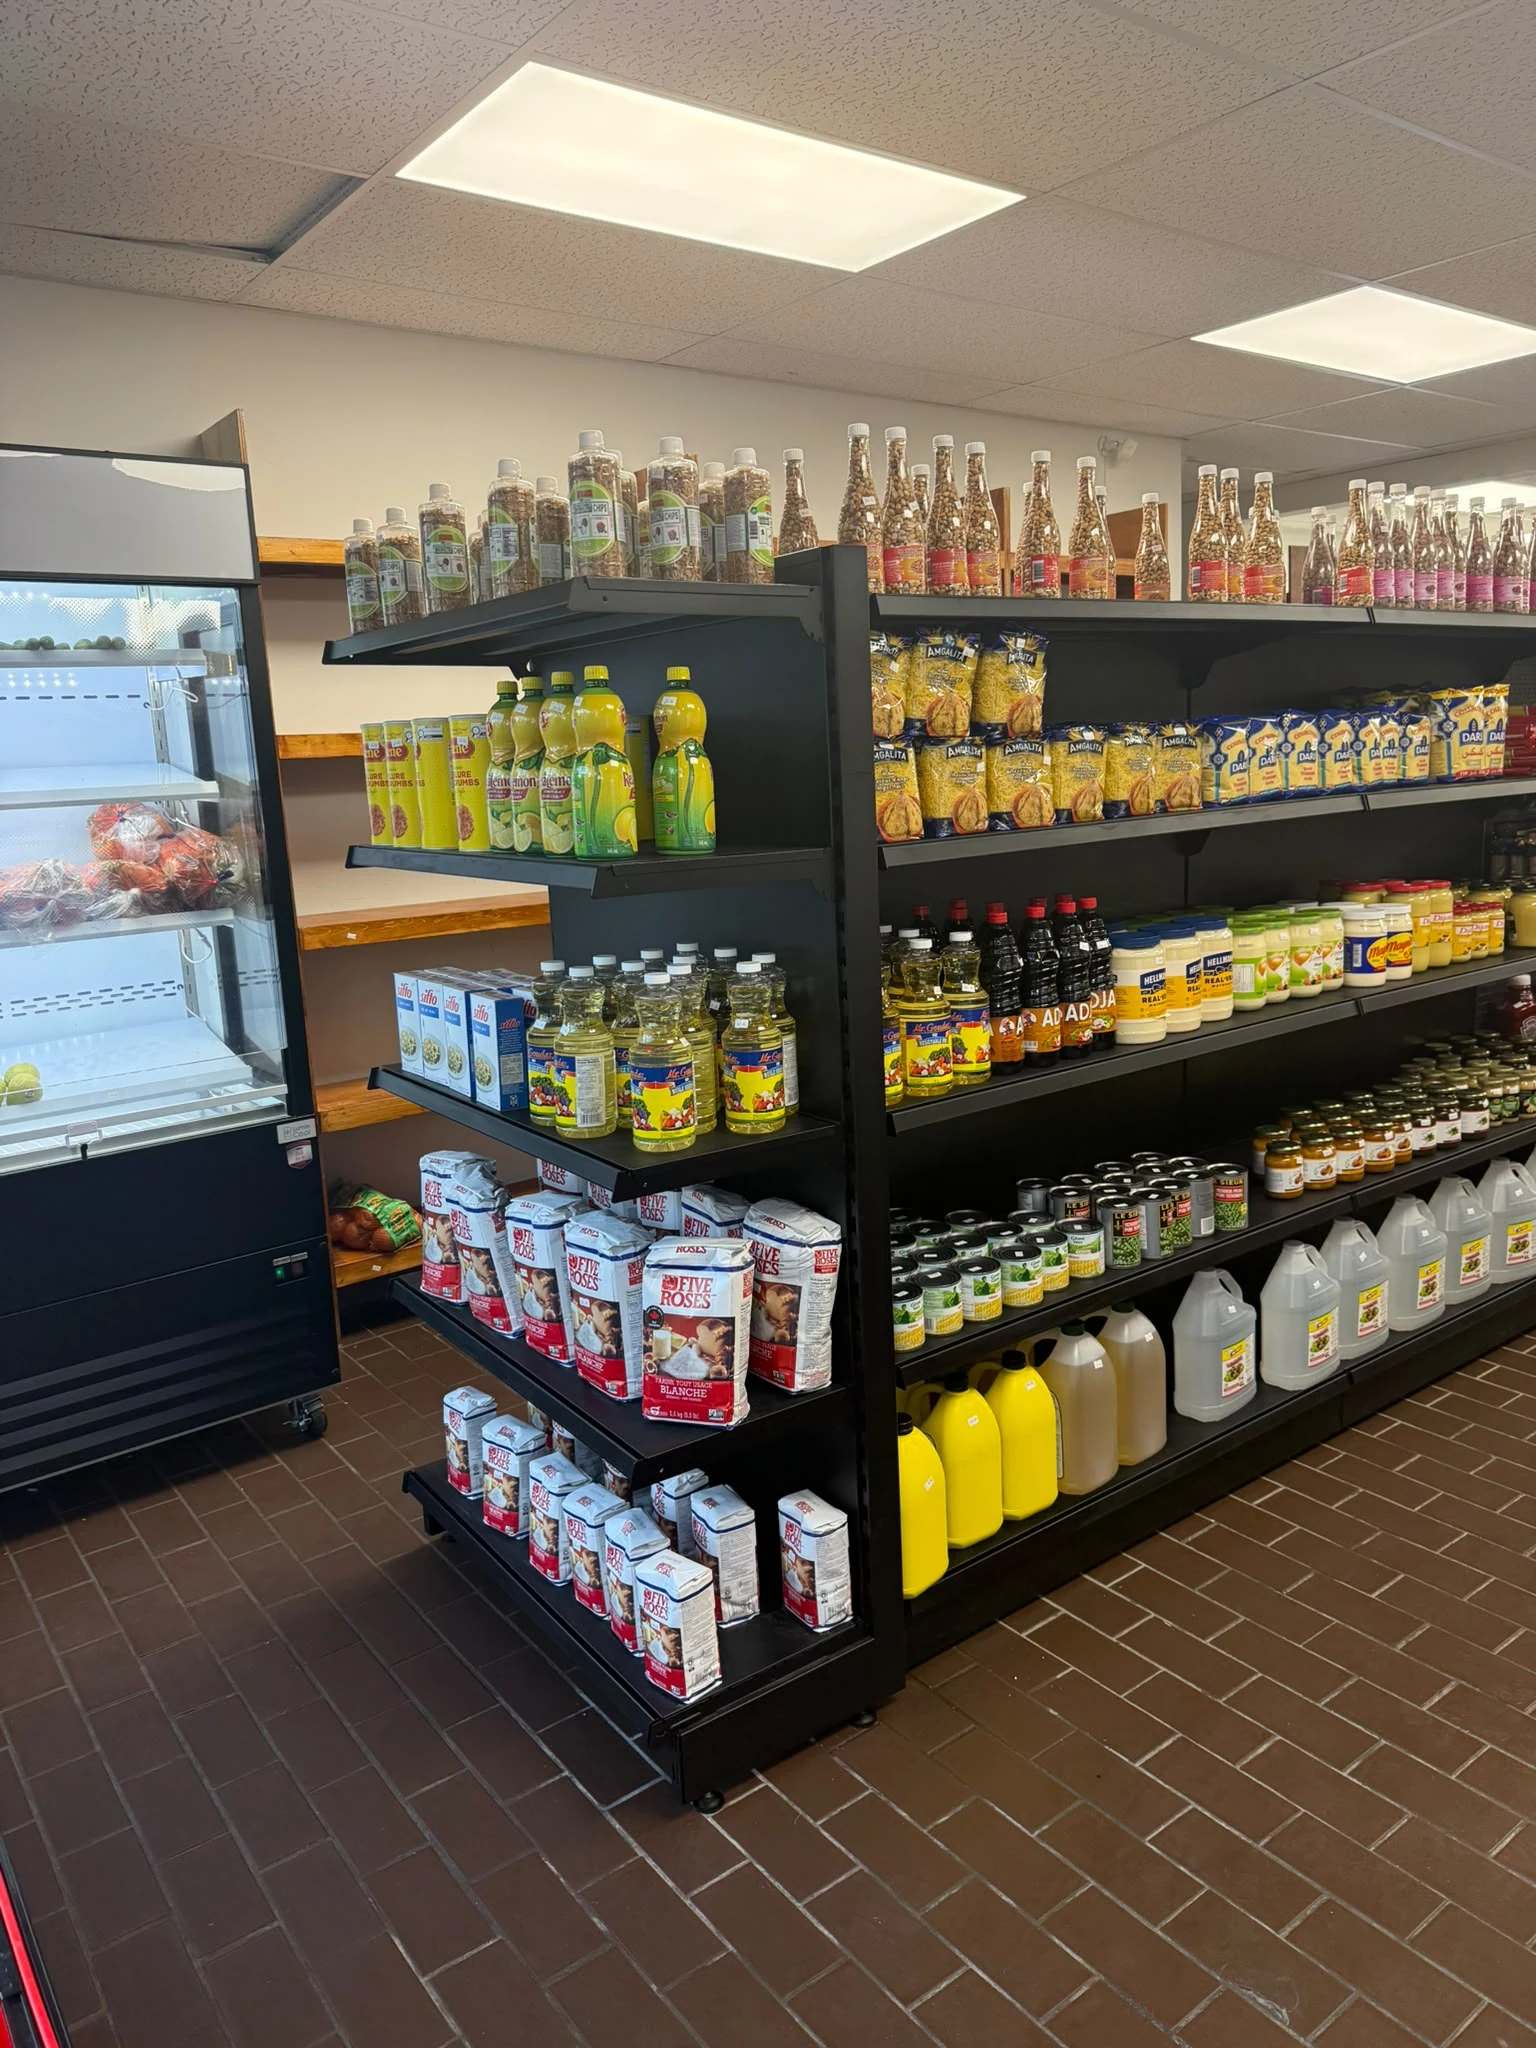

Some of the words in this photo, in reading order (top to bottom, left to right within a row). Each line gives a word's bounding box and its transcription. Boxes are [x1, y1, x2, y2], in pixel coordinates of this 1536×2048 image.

[927, 646, 965, 661] AMGALITA
[1005, 742, 1043, 755] AMGALITA
[1070, 743, 1102, 753] AMGALITA
[1163, 737, 1196, 748] AMGALITA
[874, 750, 906, 760] MGALITA
[542, 1169, 566, 1185] ROSES
[648, 1195, 667, 1209] FIVE
[640, 1207, 666, 1222] ROSES
[675, 1246, 707, 1254] ROSES
[823, 1248, 838, 1259] FIVE
[578, 1256, 600, 1277] FIVE
[815, 1256, 839, 1265] ROSES
[569, 1269, 599, 1292] ROSES
[679, 1276, 713, 1293] FIVE
[660, 1290, 711, 1309] ROSES
[660, 1384, 707, 1398] BLANCHE
[676, 1380, 692, 1388] TOUT
[693, 1381, 713, 1389] USAGE
